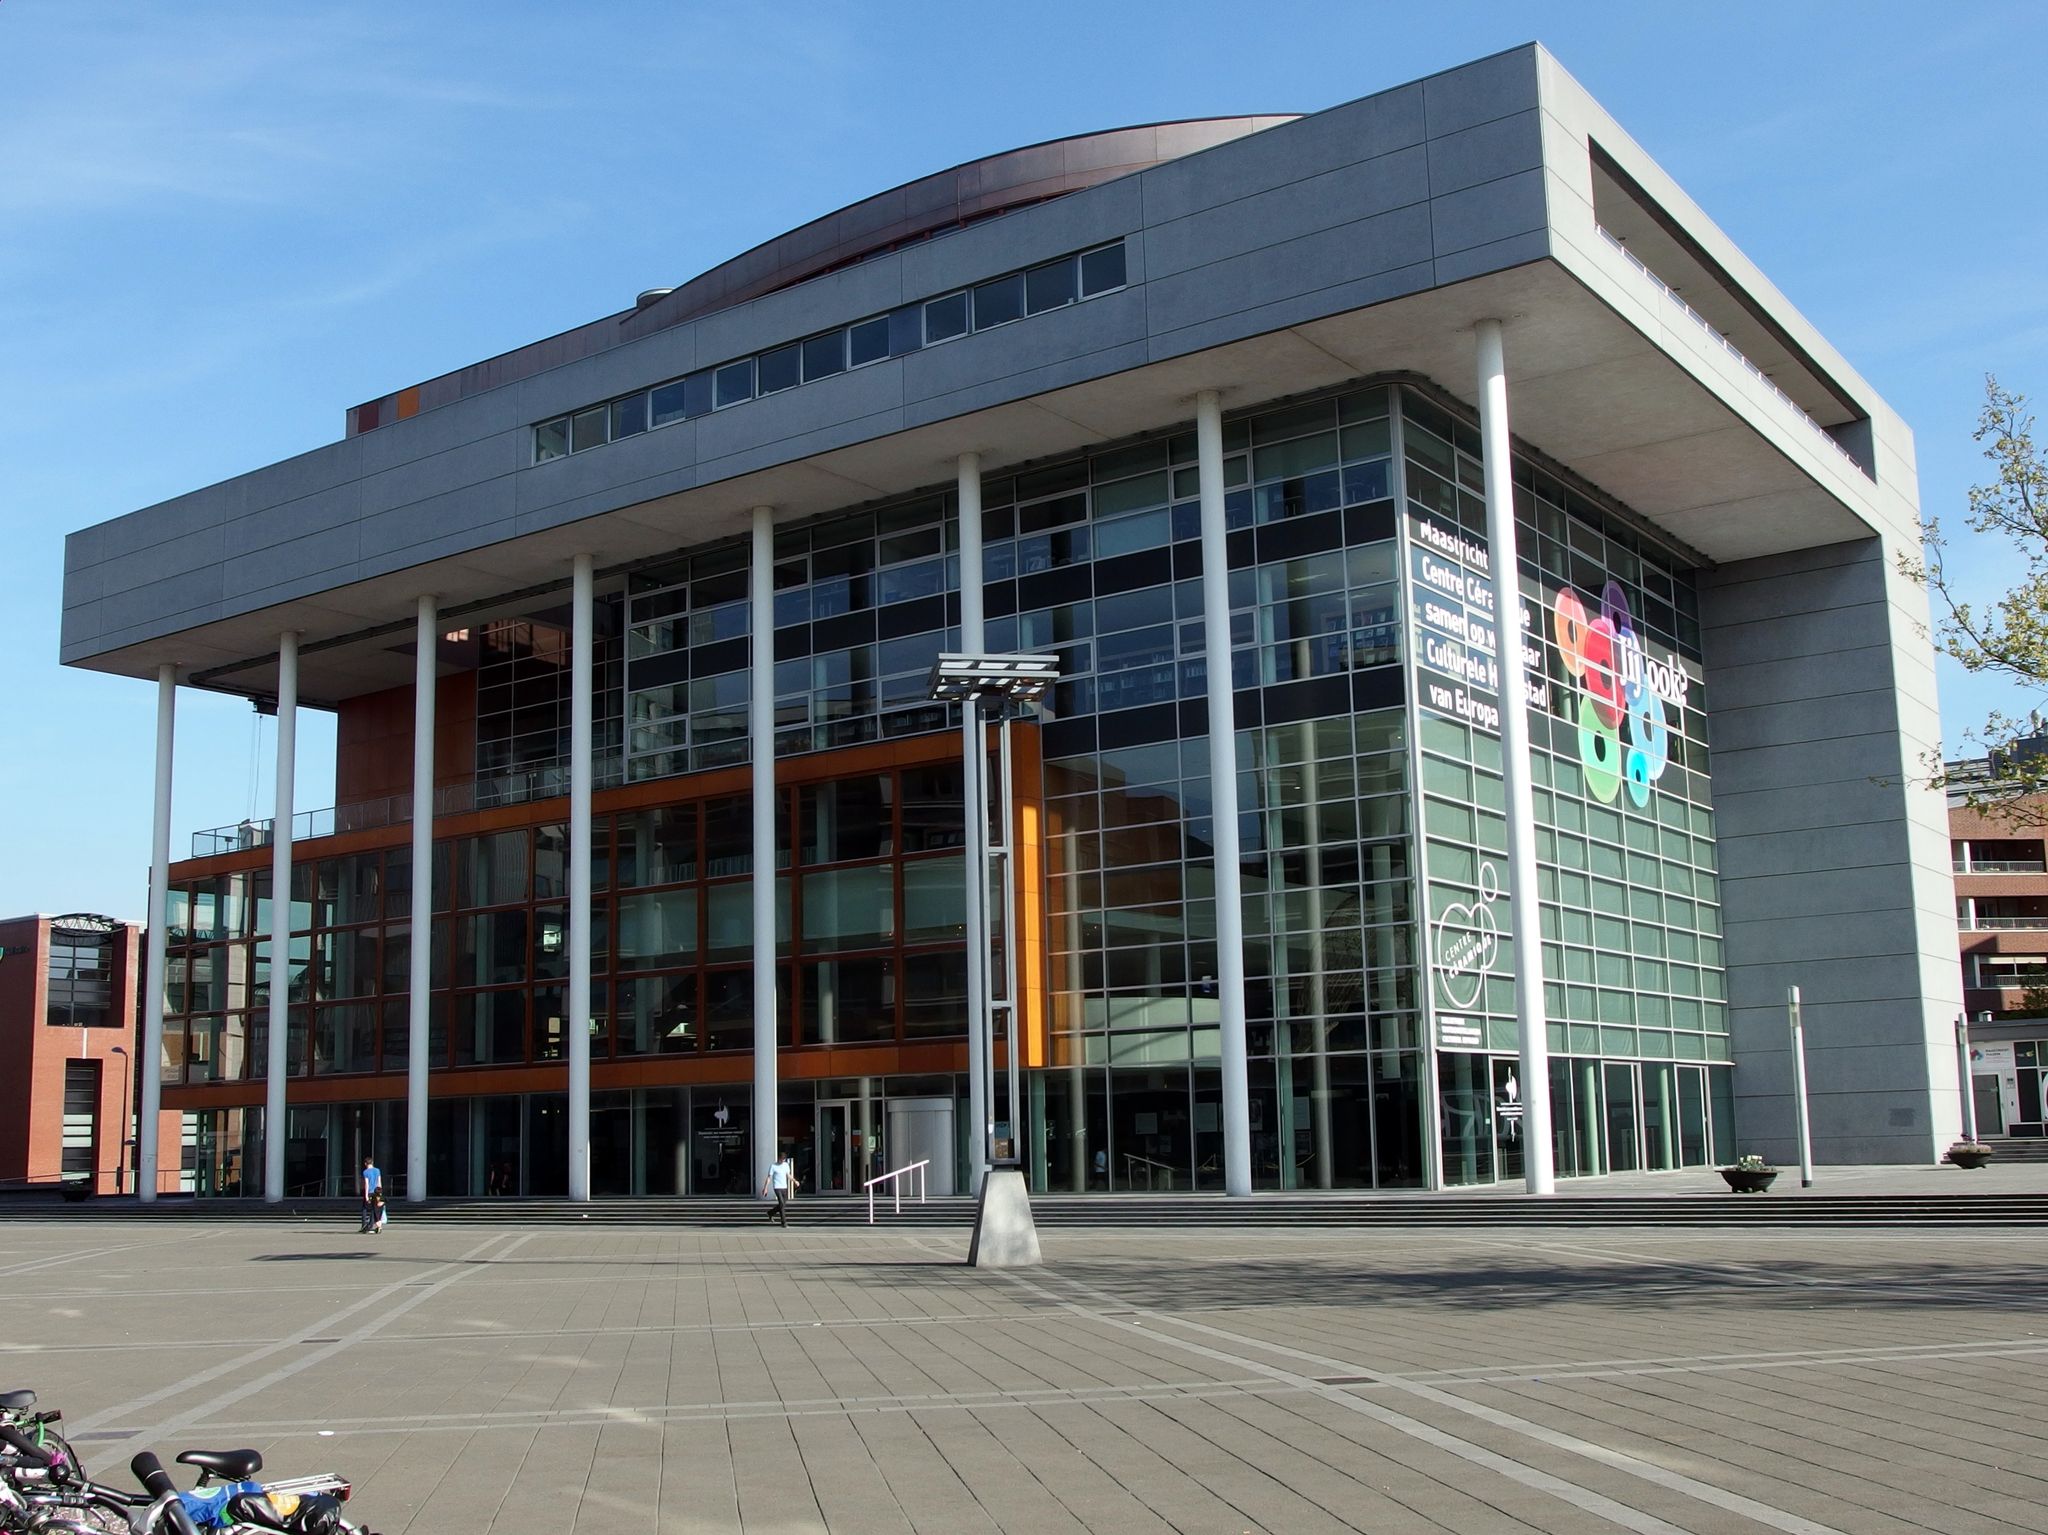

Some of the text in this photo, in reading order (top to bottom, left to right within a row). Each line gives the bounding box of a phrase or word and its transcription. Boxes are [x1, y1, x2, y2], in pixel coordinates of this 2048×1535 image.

[1420, 519, 1488, 570] Maastricht
[1422, 556, 1464, 596] Centre
[1425, 602, 1465, 636] samen
[1470, 623, 1485, 646] op
[1427, 638, 1487, 684] Culturele
[1618, 634, 1688, 706] Jij ook?
[1429, 684, 1499, 728] van Europa
[1445, 931, 1472, 962] CENTRE
[1448, 934, 1492, 979] CÉRAMIQUE
